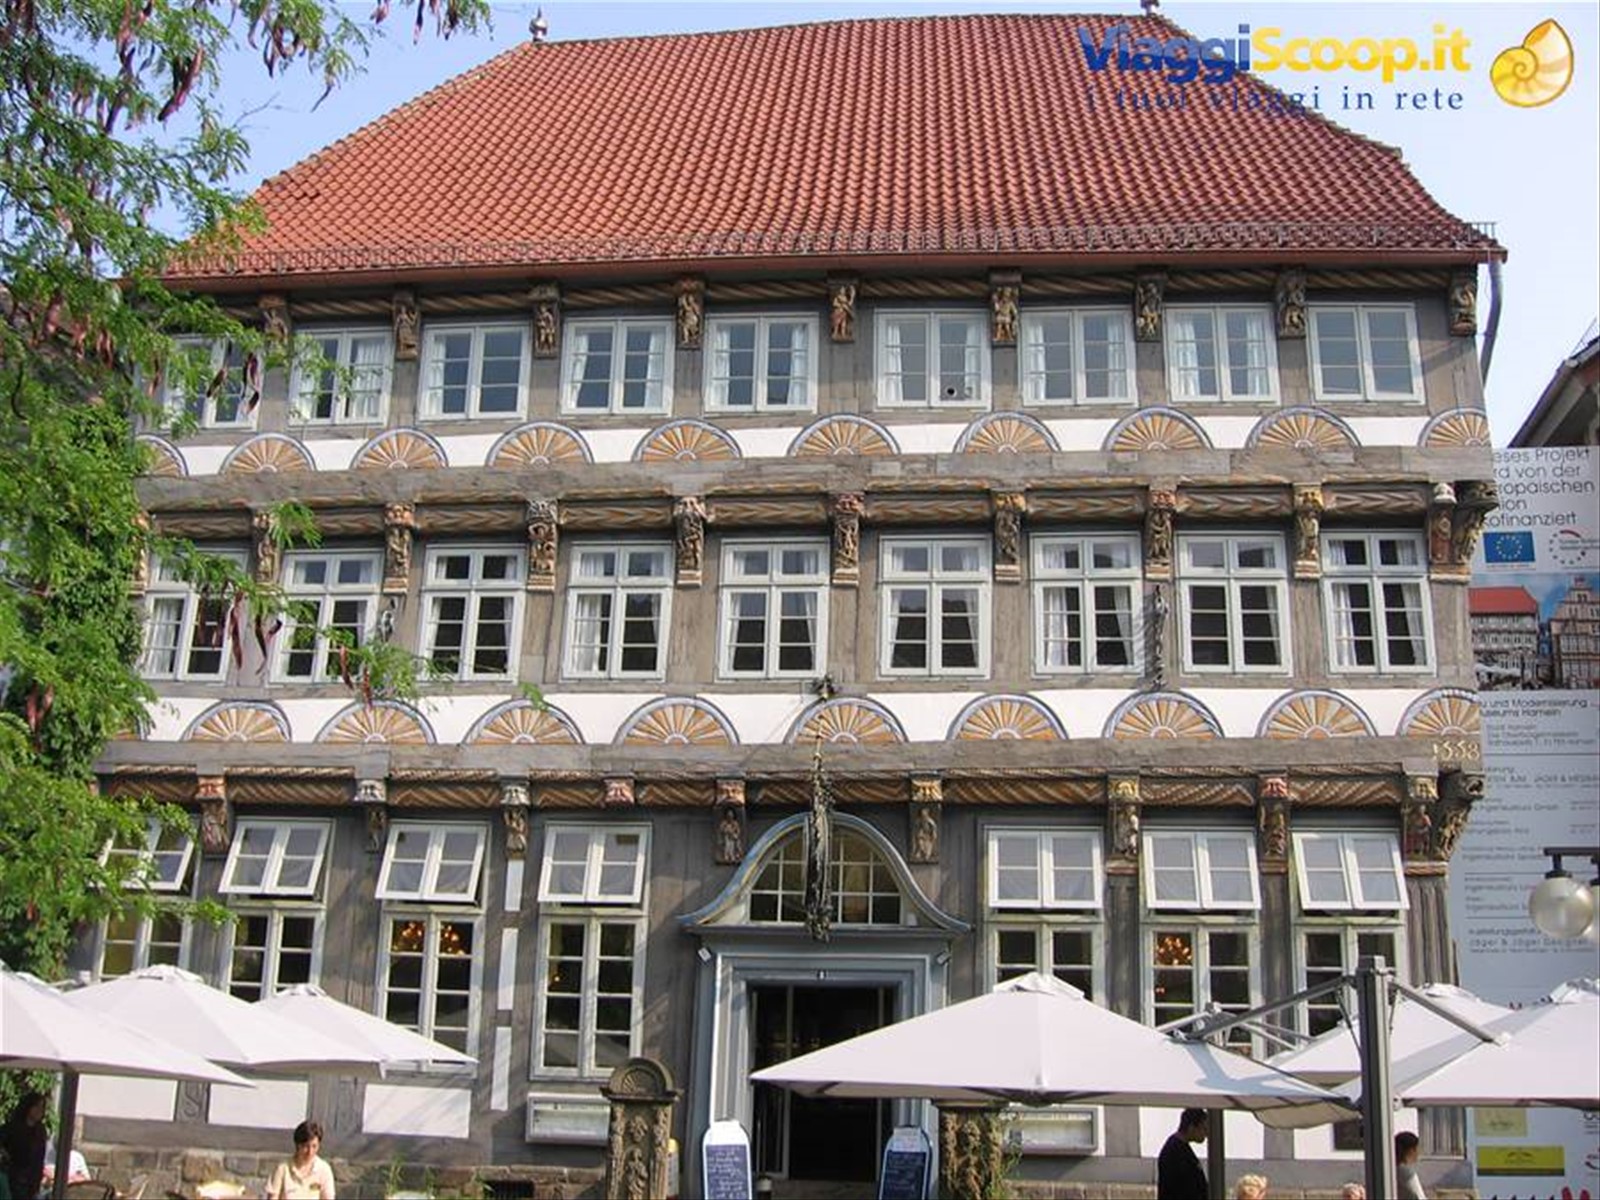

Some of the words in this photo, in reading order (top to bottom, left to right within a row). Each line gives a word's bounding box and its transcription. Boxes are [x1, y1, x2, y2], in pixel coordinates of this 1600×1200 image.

[1535, 448, 1590, 463] Projekt
[1514, 467, 1548, 478] von
[1552, 463, 1580, 478] der
